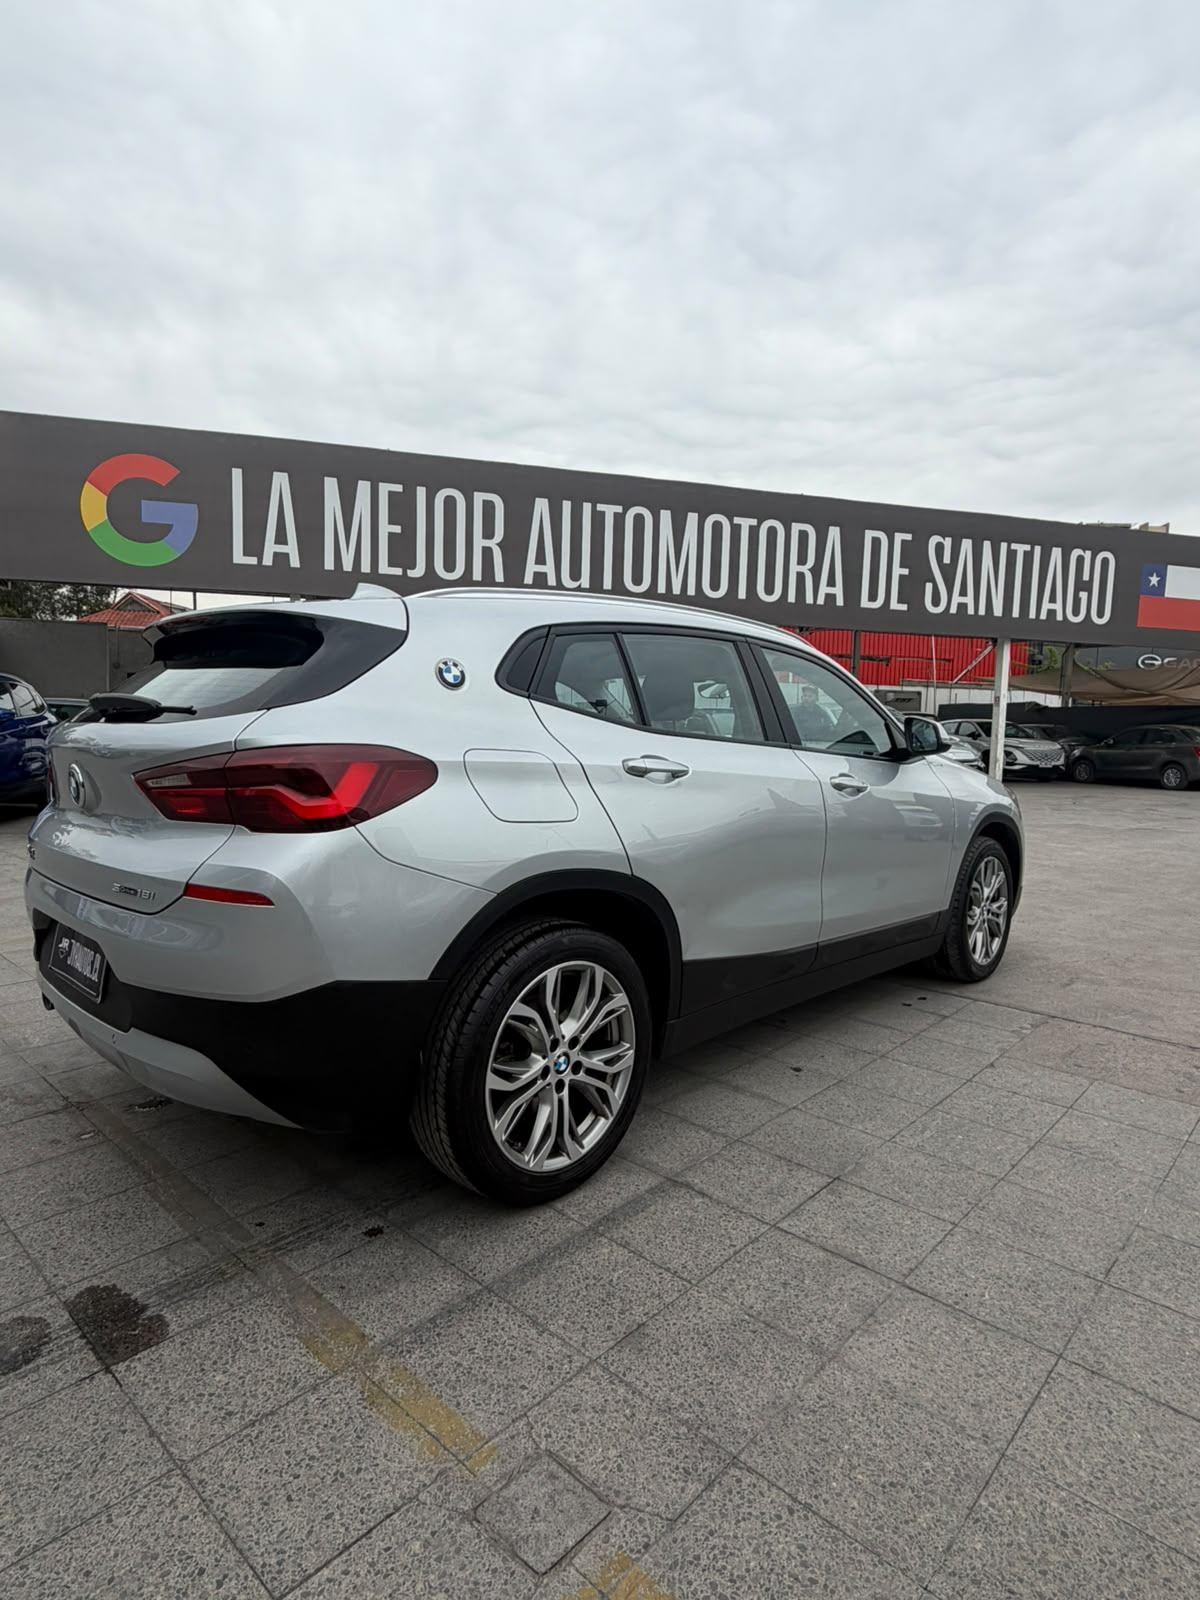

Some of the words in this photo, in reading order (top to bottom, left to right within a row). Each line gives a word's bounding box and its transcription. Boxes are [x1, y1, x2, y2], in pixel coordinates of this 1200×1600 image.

[231, 467, 301, 569] LA
[323, 476, 505, 584] MEJOR
[523, 497, 845, 607] AUTOMOTORA
[860, 529, 913, 611] DE
[924, 534, 1117, 626] SANTIAGO
